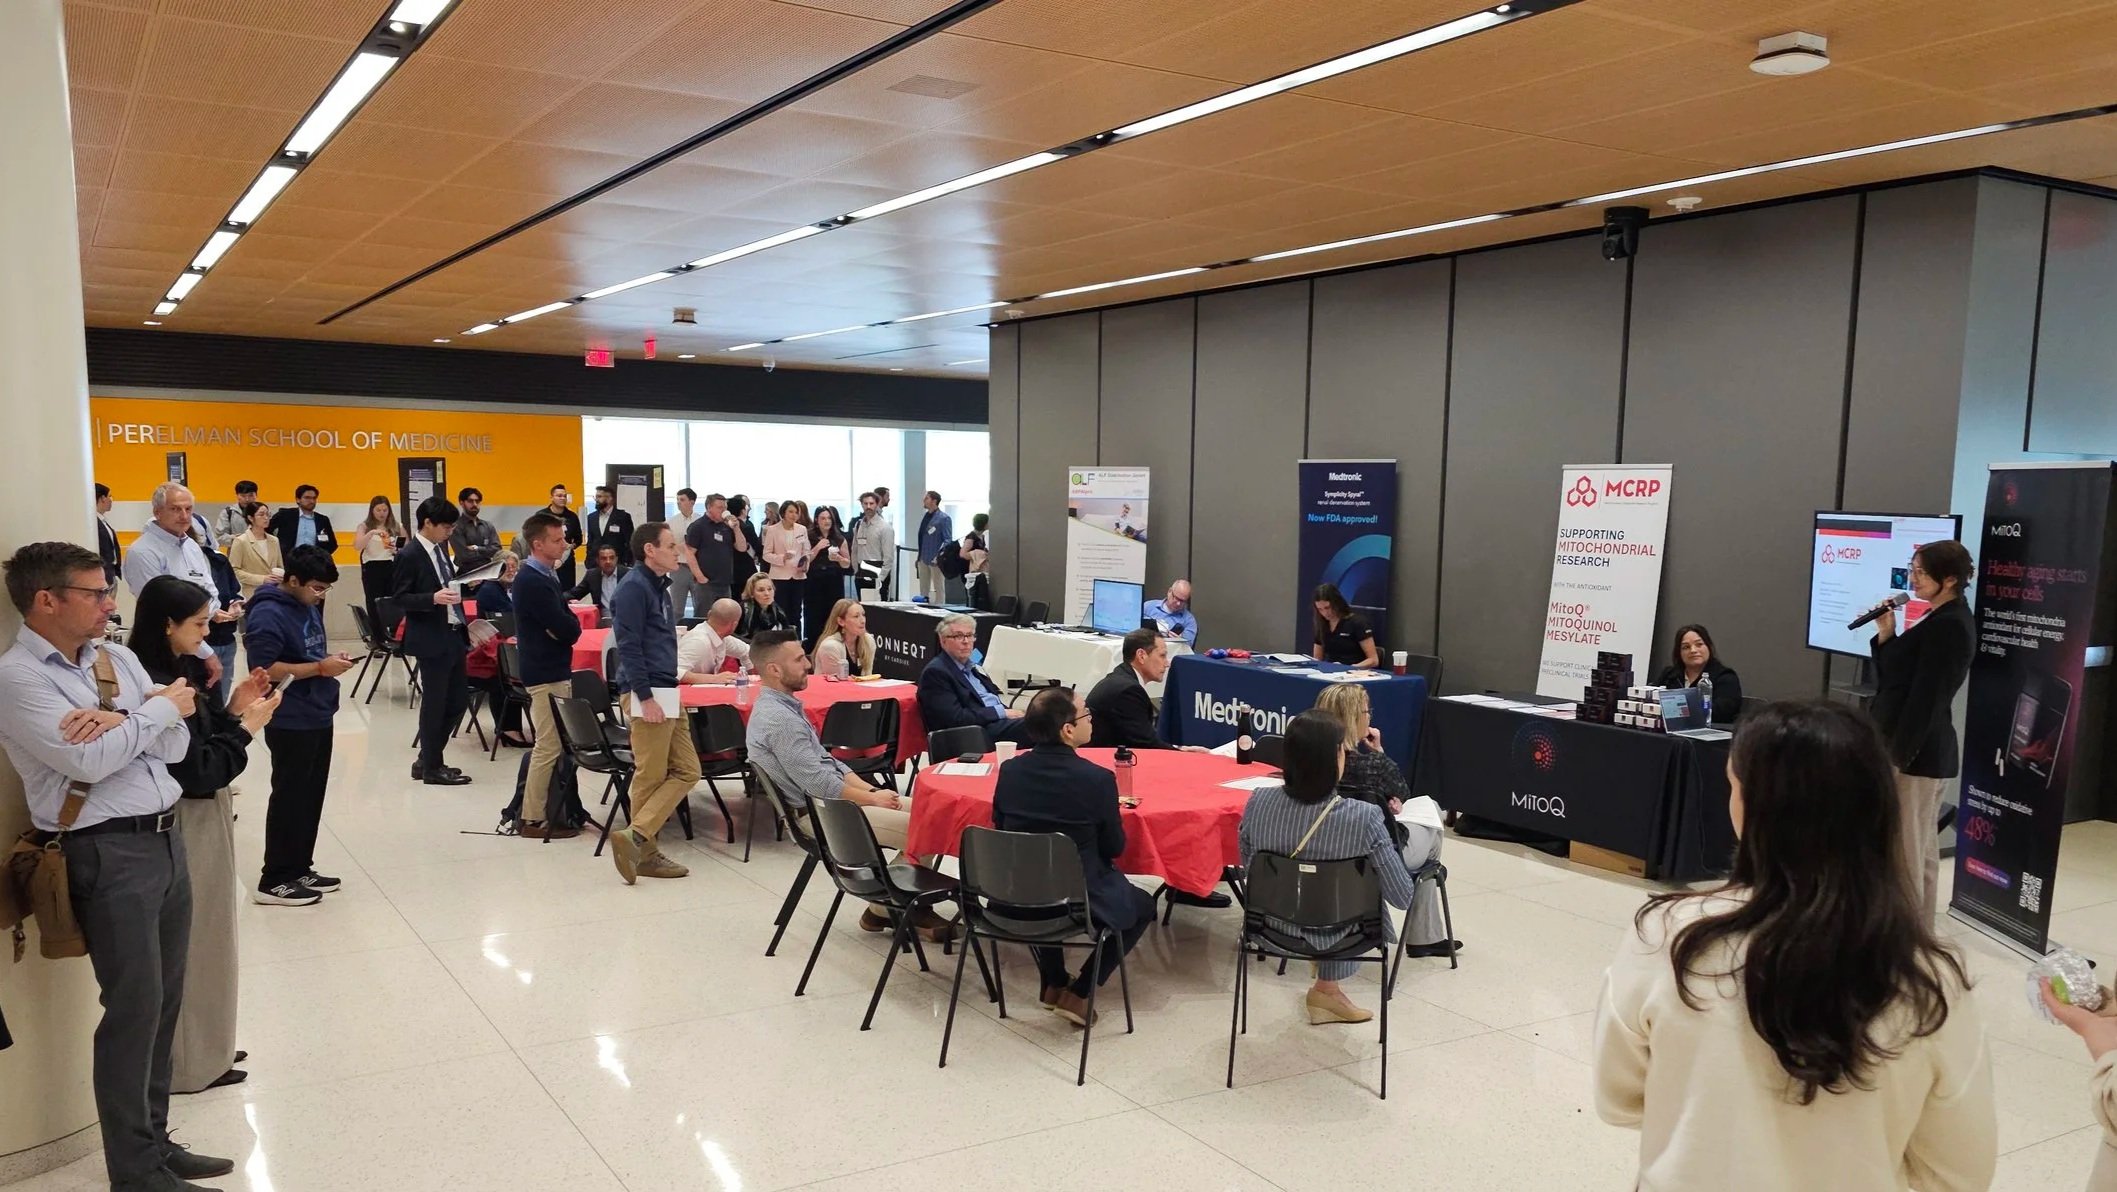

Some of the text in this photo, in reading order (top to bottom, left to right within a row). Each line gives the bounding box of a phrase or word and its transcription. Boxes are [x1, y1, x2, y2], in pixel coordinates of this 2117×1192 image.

[108, 423, 495, 453] PERELMAN SCHOOL OF MEDICINE
[1328, 472, 1362, 481] Medtronic
[1324, 490, 1348, 499] Symplicity
[1605, 479, 1661, 497] MCRP
[1307, 514, 1379, 525] Now FDA approved!
[1560, 528, 1625, 541] SUPPORTING
[1558, 541, 1657, 557] MITOCHONDRIAL
[1837, 548, 1862, 560] MCRP
[1556, 554, 1611, 568] RESEARCH
[2026, 563, 2056, 584] aging
[2057, 567, 2088, 584] starts
[1577, 583, 1613, 592] ANTIOXIDANT
[1985, 581, 1997, 597] in
[1997, 584, 2020, 601] your
[1984, 607, 1996, 618] The
[1548, 617, 1618, 633] MITOQUINOL
[2012, 623, 2021, 633] for
[2021, 625, 2043, 637] cellular
[1546, 630, 1602, 646] MESYLATE
[2020, 637, 2039, 649] health
[876, 634, 927, 660] ONNEQT
[1550, 661, 1575, 669] SUPPORT
[1194, 691, 1296, 735] Medoni
[1967, 798, 1981, 809] stress
[1968, 784, 1986, 799] Shown
[1991, 795, 2010, 808] reduce
[2009, 801, 2033, 816] oxidative
[1964, 815, 1997, 847] 48%
